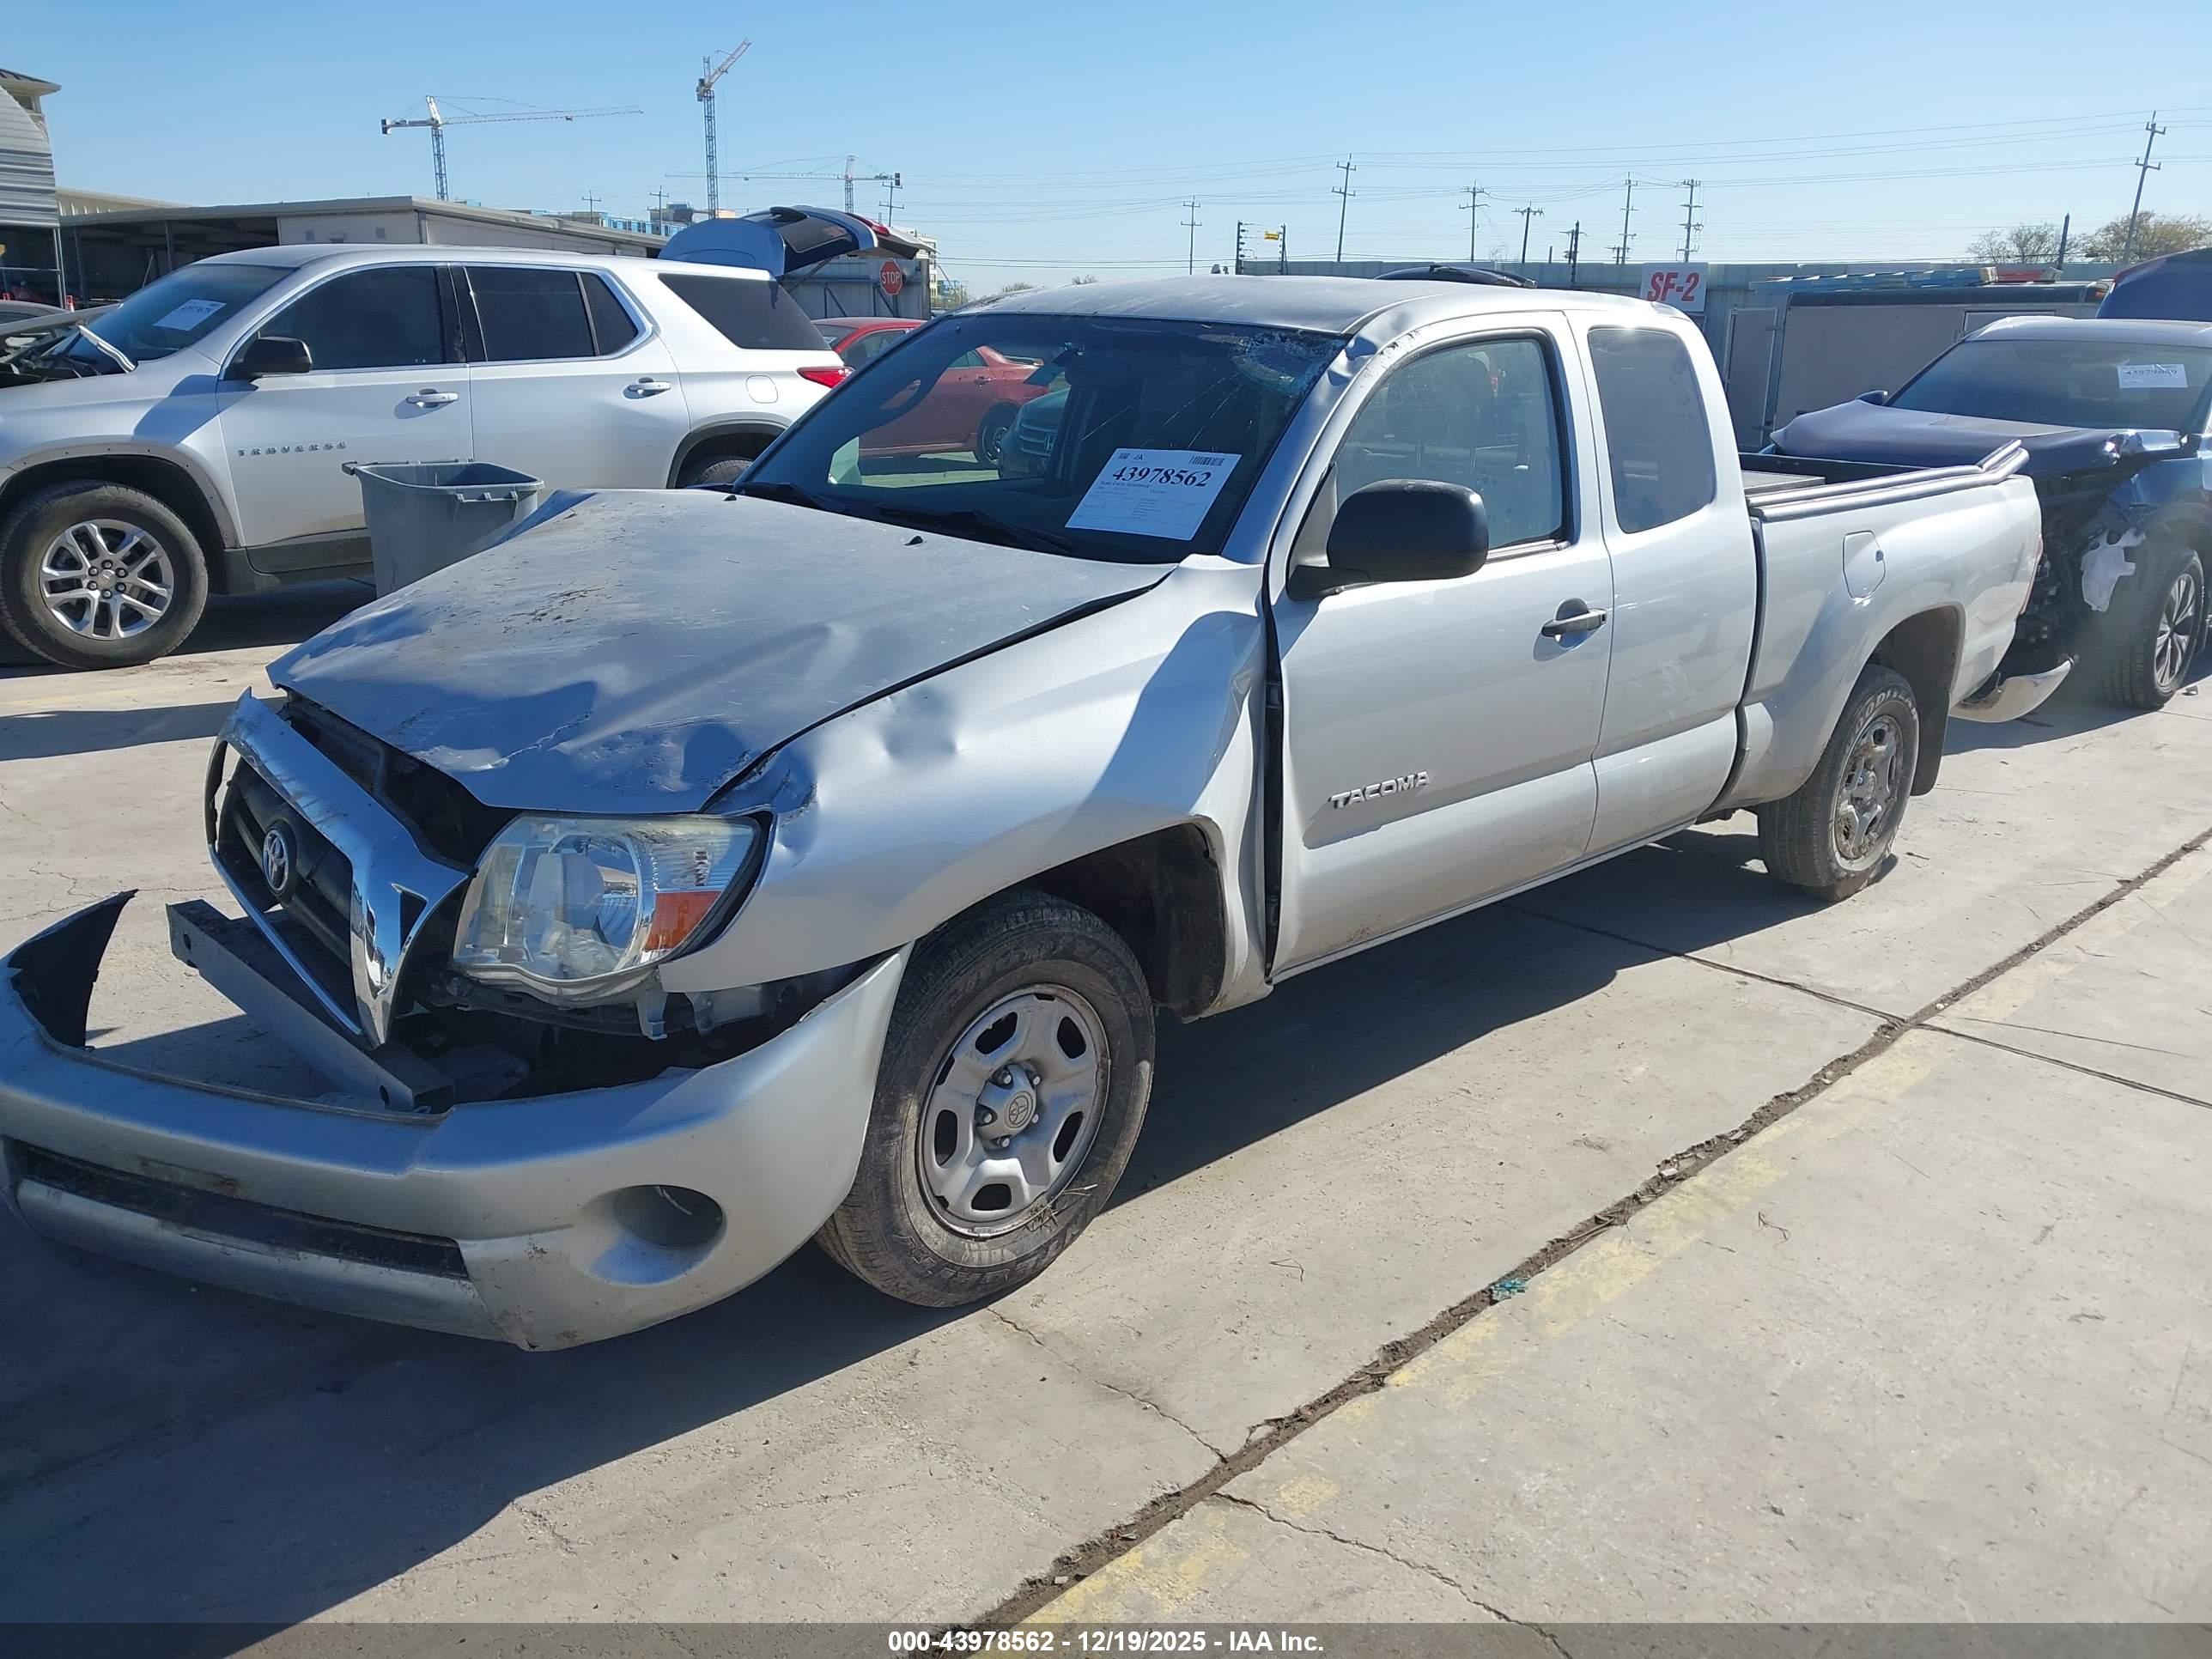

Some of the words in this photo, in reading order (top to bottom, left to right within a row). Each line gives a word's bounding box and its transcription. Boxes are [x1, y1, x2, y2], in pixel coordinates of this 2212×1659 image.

[882, 271, 900, 284] STOP
[1648, 271, 1699, 301] SF-2
[238, 442, 346, 457] TRAVERSE
[1112, 465, 1212, 487] 43978562
[1846, 690, 1917, 753] OODYEAR
[1328, 770, 1430, 809] TACOMA
